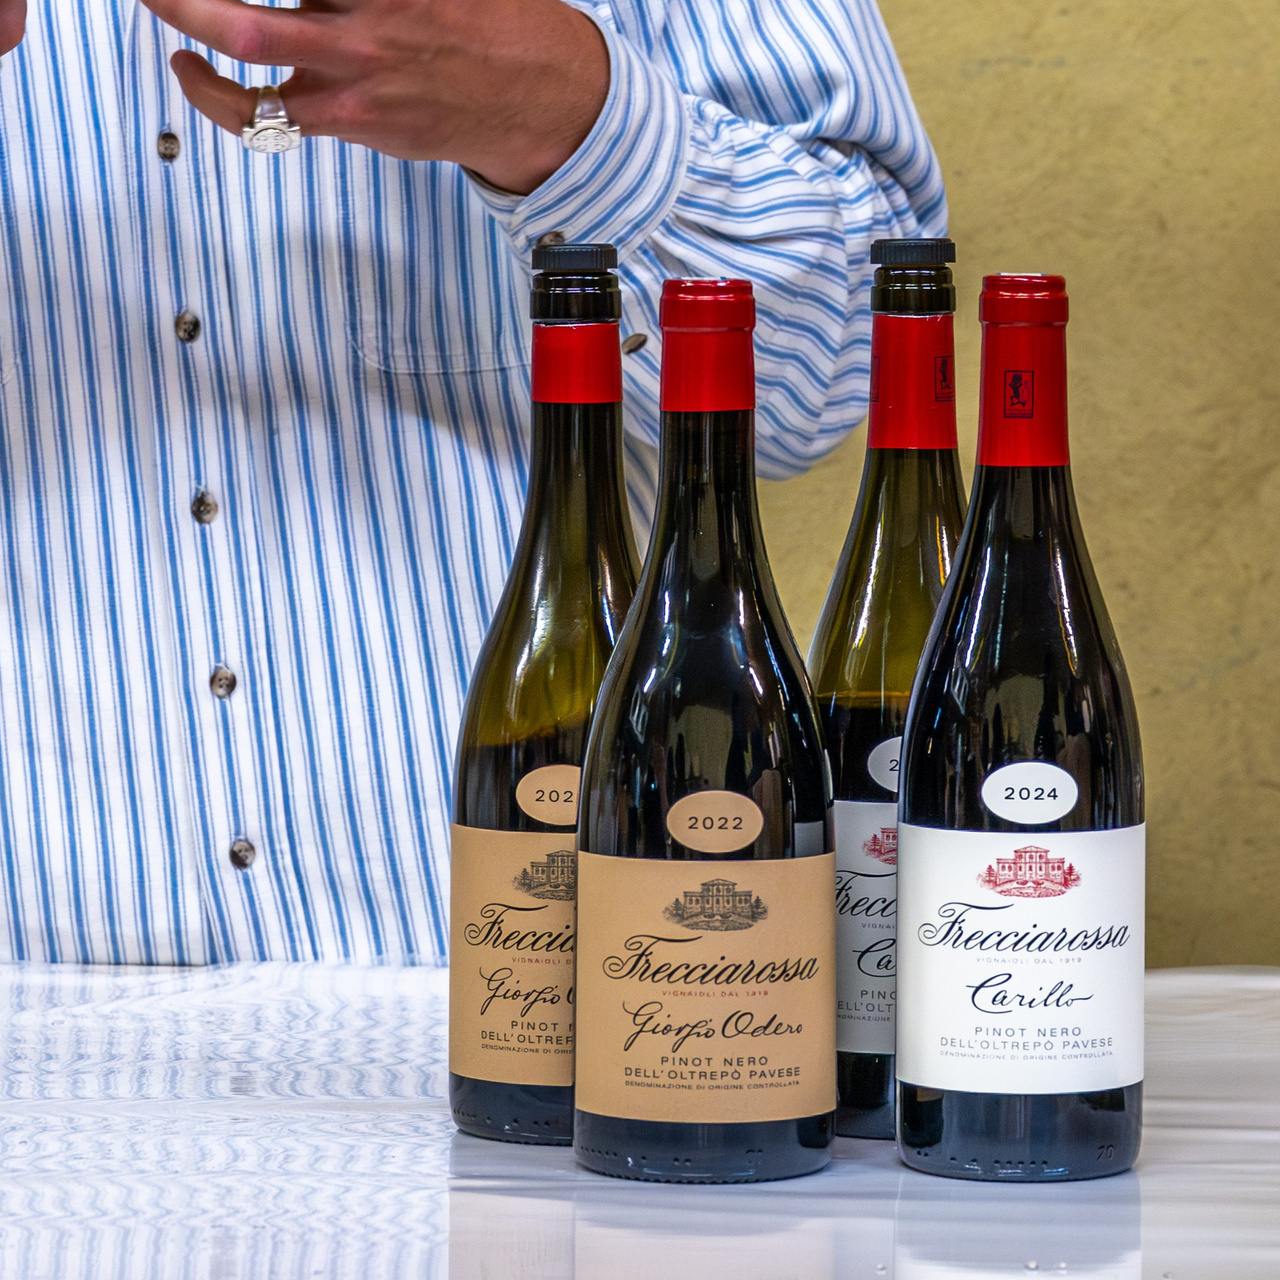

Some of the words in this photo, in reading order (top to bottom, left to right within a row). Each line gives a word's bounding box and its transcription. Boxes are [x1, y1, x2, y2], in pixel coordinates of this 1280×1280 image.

[535, 790, 574, 802] 202
[1004, 786, 1058, 800] 2024
[688, 816, 743, 830] 2022
[918, 902, 1130, 952] Frecciarossa
[602, 934, 820, 985] Frecciarossa
[480, 967, 561, 1018] Giorgio
[860, 990, 896, 1000] PINO
[966, 973, 1094, 1014] Carillo
[838, 1000, 894, 1012] ELL'OLT
[511, 1020, 558, 1032] PINOT
[622, 1001, 716, 1053] Giorgio
[721, 1010, 803, 1039] Odero
[974, 1026, 1027, 1038] PINOT
[1037, 1026, 1082, 1037] NERO
[1062, 1037, 1113, 1050] PAVESE
[660, 1056, 713, 1067] PINOT
[723, 1056, 768, 1067] NERO
[749, 1066, 800, 1080] PAVESE
